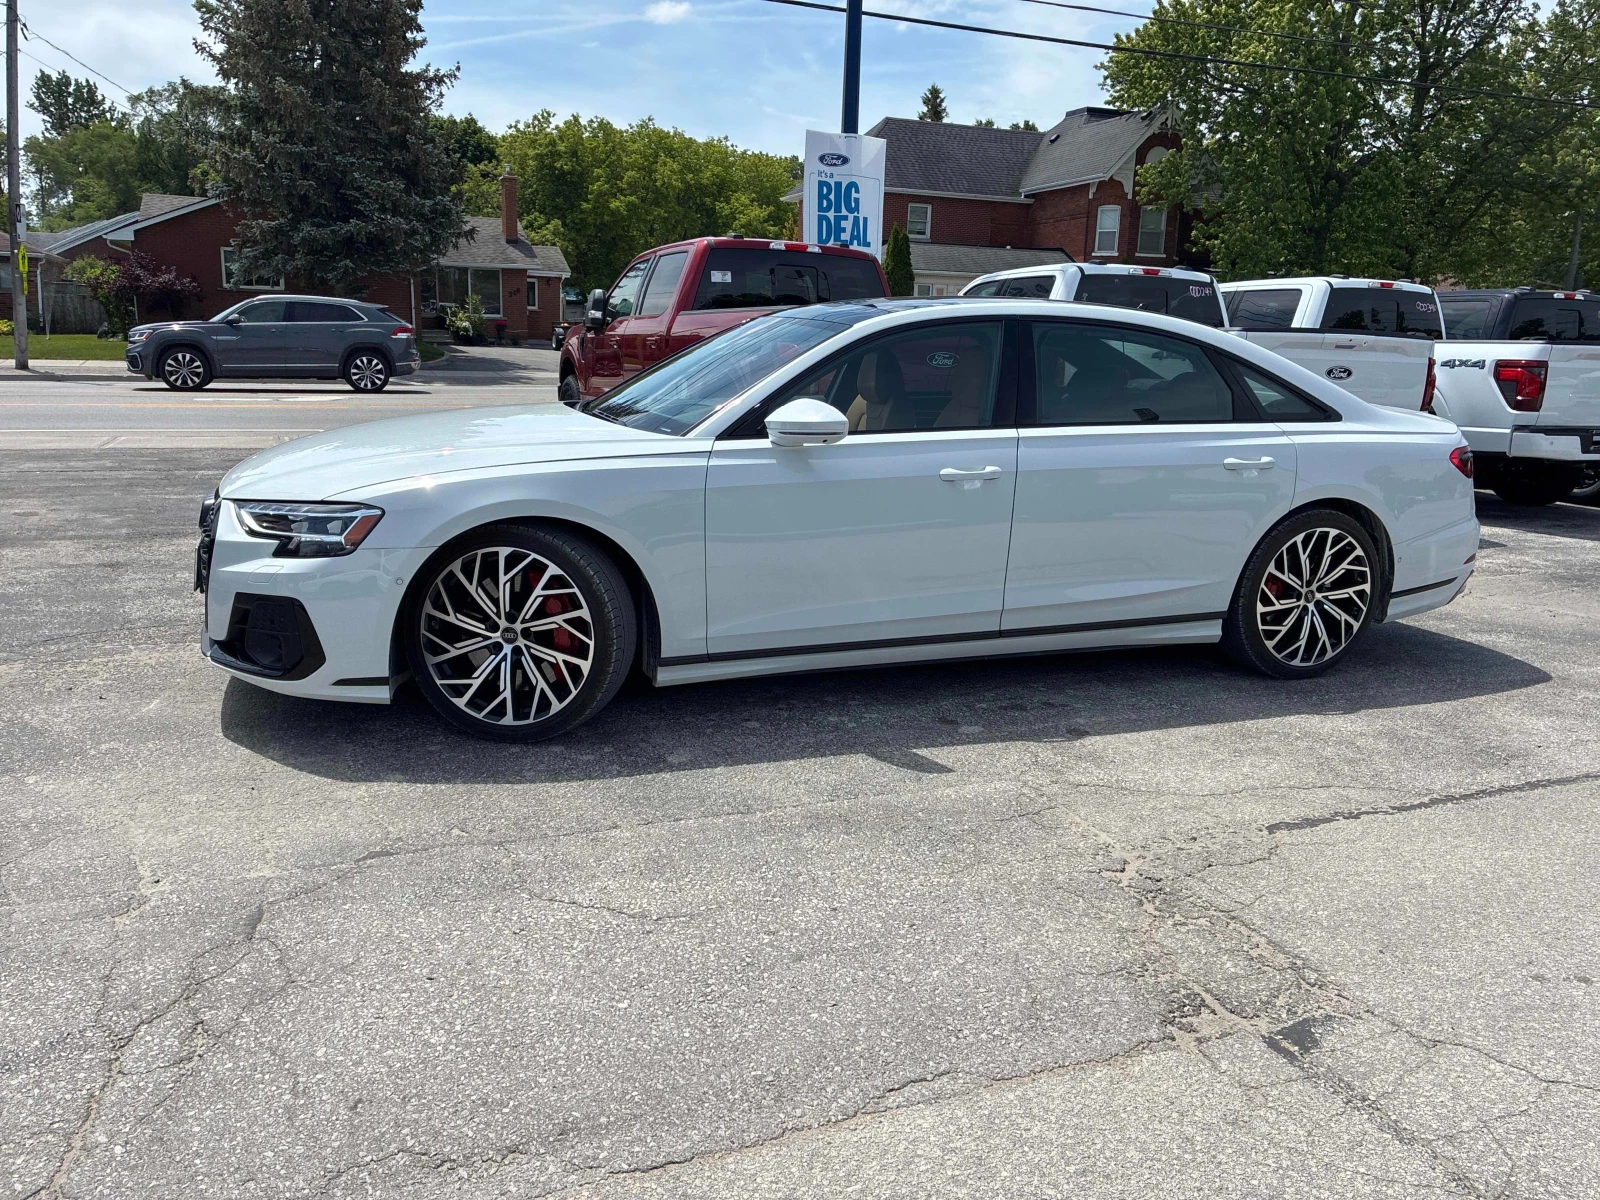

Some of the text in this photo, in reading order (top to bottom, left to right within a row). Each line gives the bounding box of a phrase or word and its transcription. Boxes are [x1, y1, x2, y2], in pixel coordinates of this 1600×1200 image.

[817, 170, 828, 178] It's
[817, 180, 860, 214] BIG
[817, 214, 871, 247] DEAL
